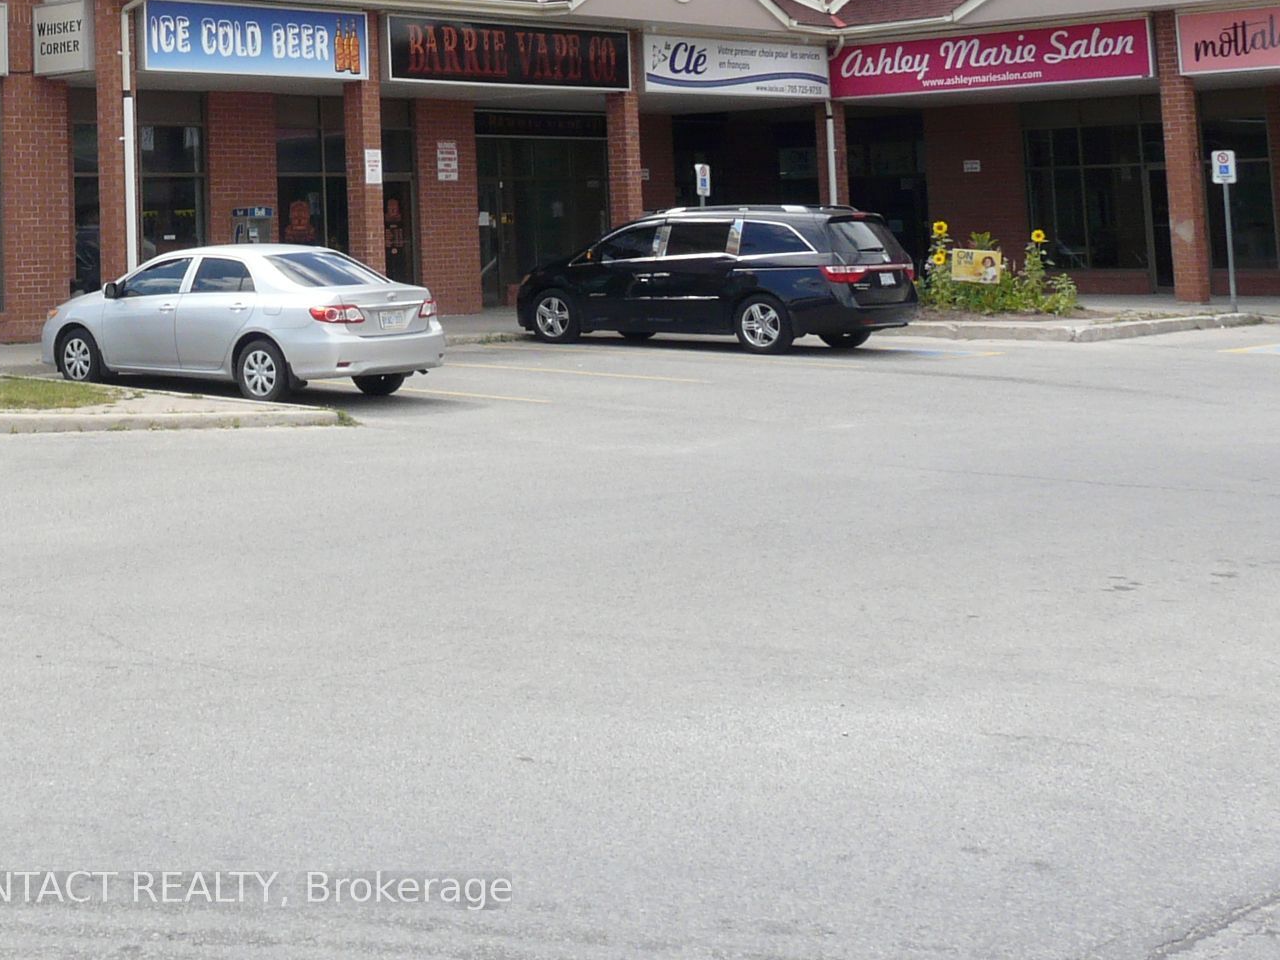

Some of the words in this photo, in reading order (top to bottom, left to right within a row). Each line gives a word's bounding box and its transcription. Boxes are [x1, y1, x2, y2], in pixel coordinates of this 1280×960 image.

[37, 19, 82, 37] WHISKEY
[150, 15, 191, 54] ICE
[201, 17, 262, 57] COLD
[271, 22, 329, 61] BEER
[40, 40, 80, 56] CORNER
[407, 24, 509, 78] BARRIE
[514, 32, 582, 81] VAPE
[589, 35, 617, 82] CO.
[717, 45, 733, 56] Votre
[734, 47, 757, 57] premier
[758, 48, 774, 58] choix
[774, 50, 789, 60] pour
[799, 50, 821, 61] services
[840, 46, 930, 80] Ashley
[939, 34, 1037, 70] Marie
[1043, 27, 1134, 64] Salon
[669, 42, 708, 75] Clé
[718, 61, 727, 69] en
[727, 59, 750, 71] français
[922, 69, 1042, 88] www.ashleymariesalon.com
